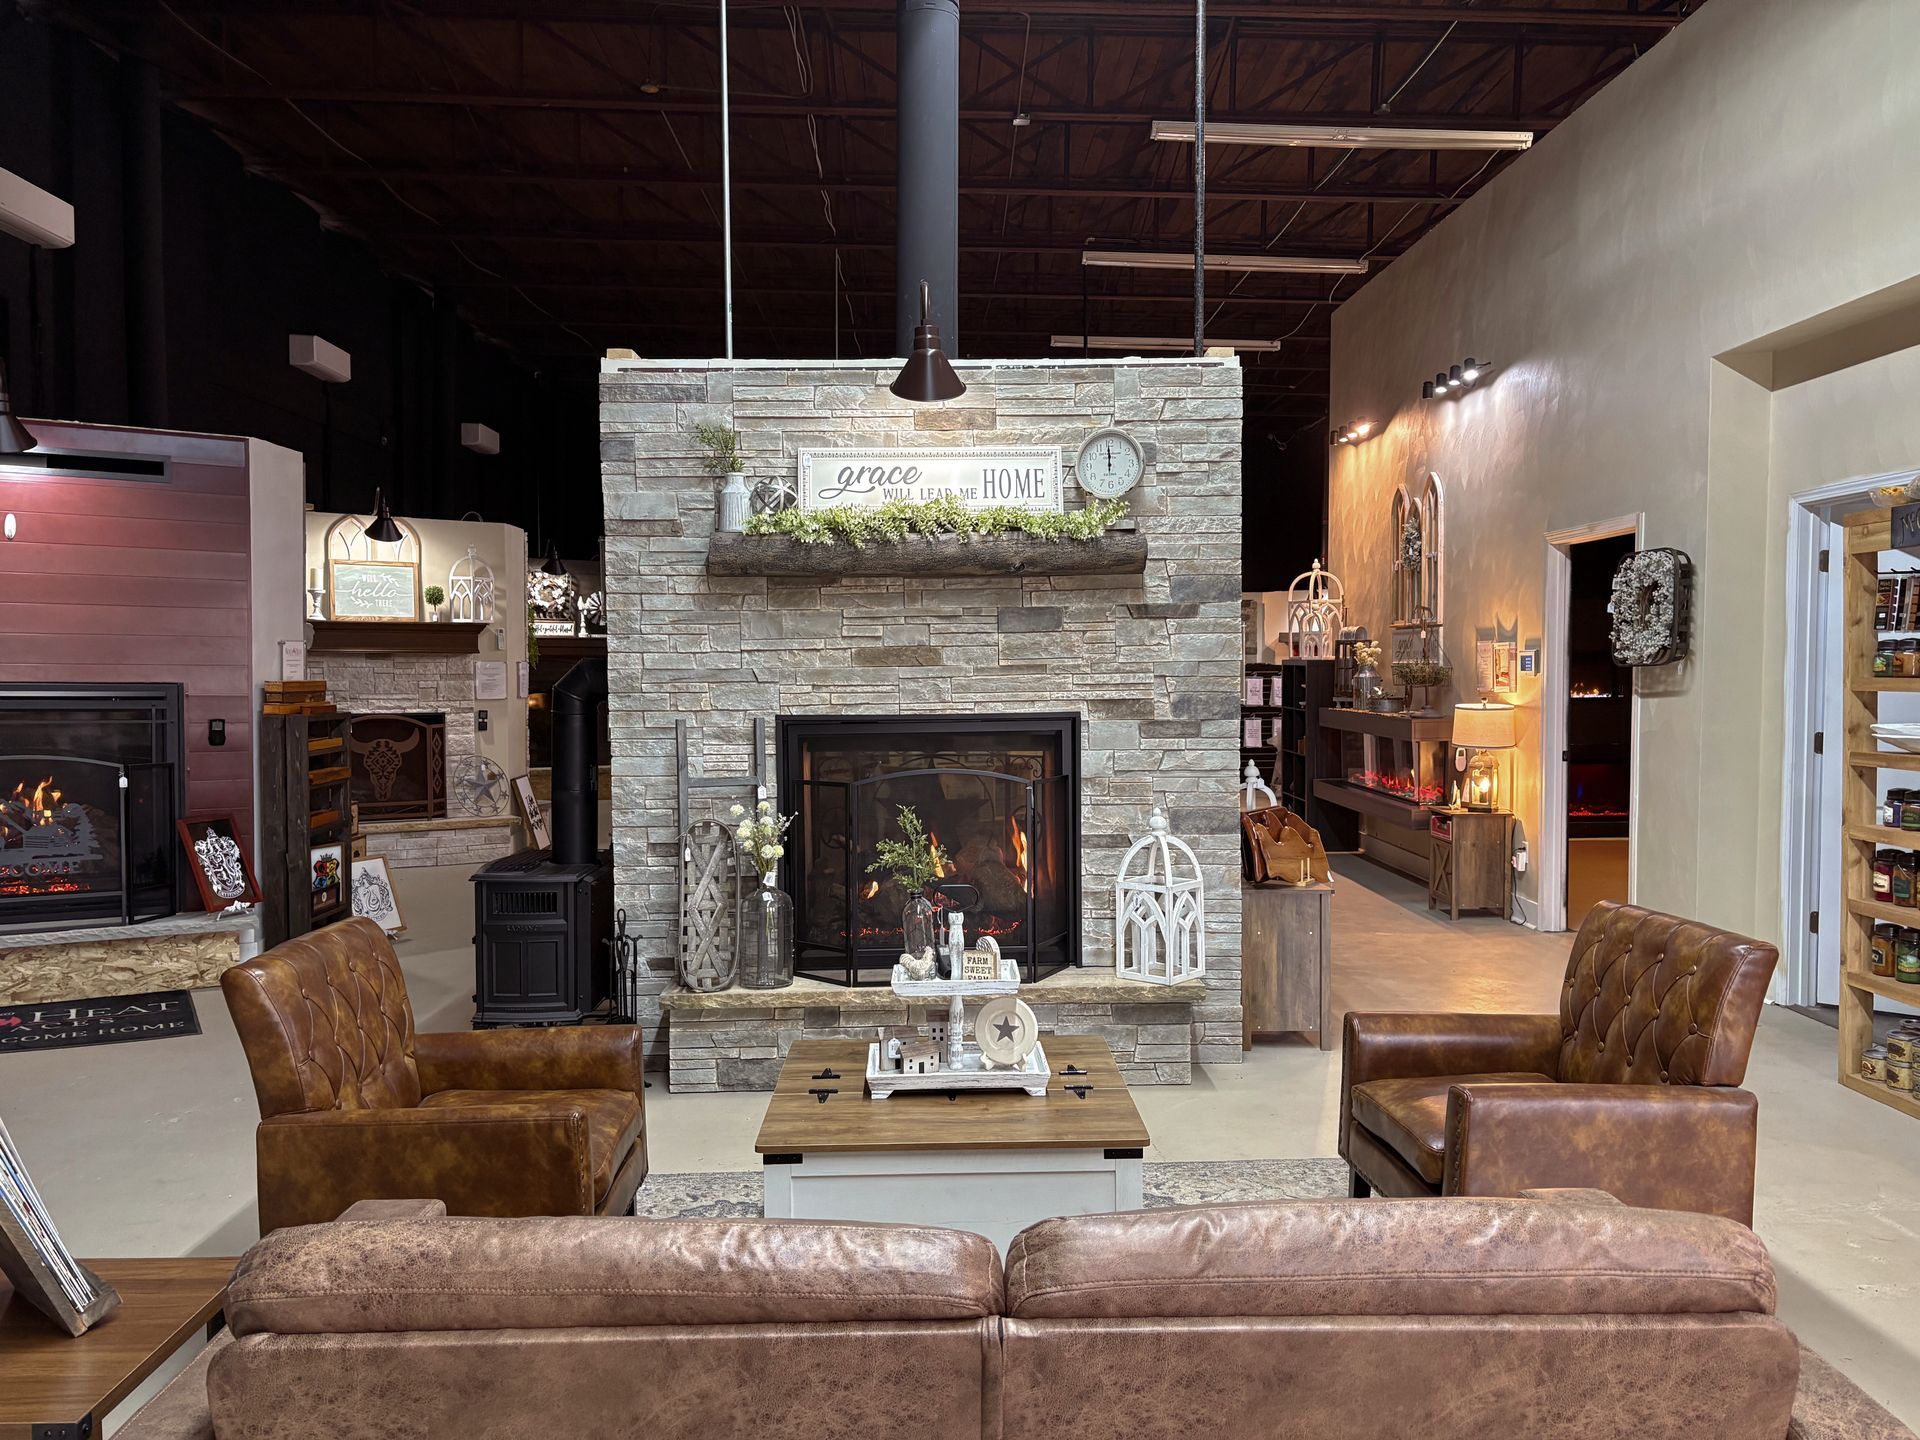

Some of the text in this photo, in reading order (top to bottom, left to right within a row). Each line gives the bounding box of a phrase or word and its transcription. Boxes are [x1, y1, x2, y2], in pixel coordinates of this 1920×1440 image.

[818, 465, 923, 500] grace
[883, 468, 1046, 501] WILL LEAD ME HOME
[351, 580, 398, 598] hello
[964, 965, 993, 975] SWEET
[966, 956, 989, 965] FARM
[29, 1001, 180, 1023] HEAT
